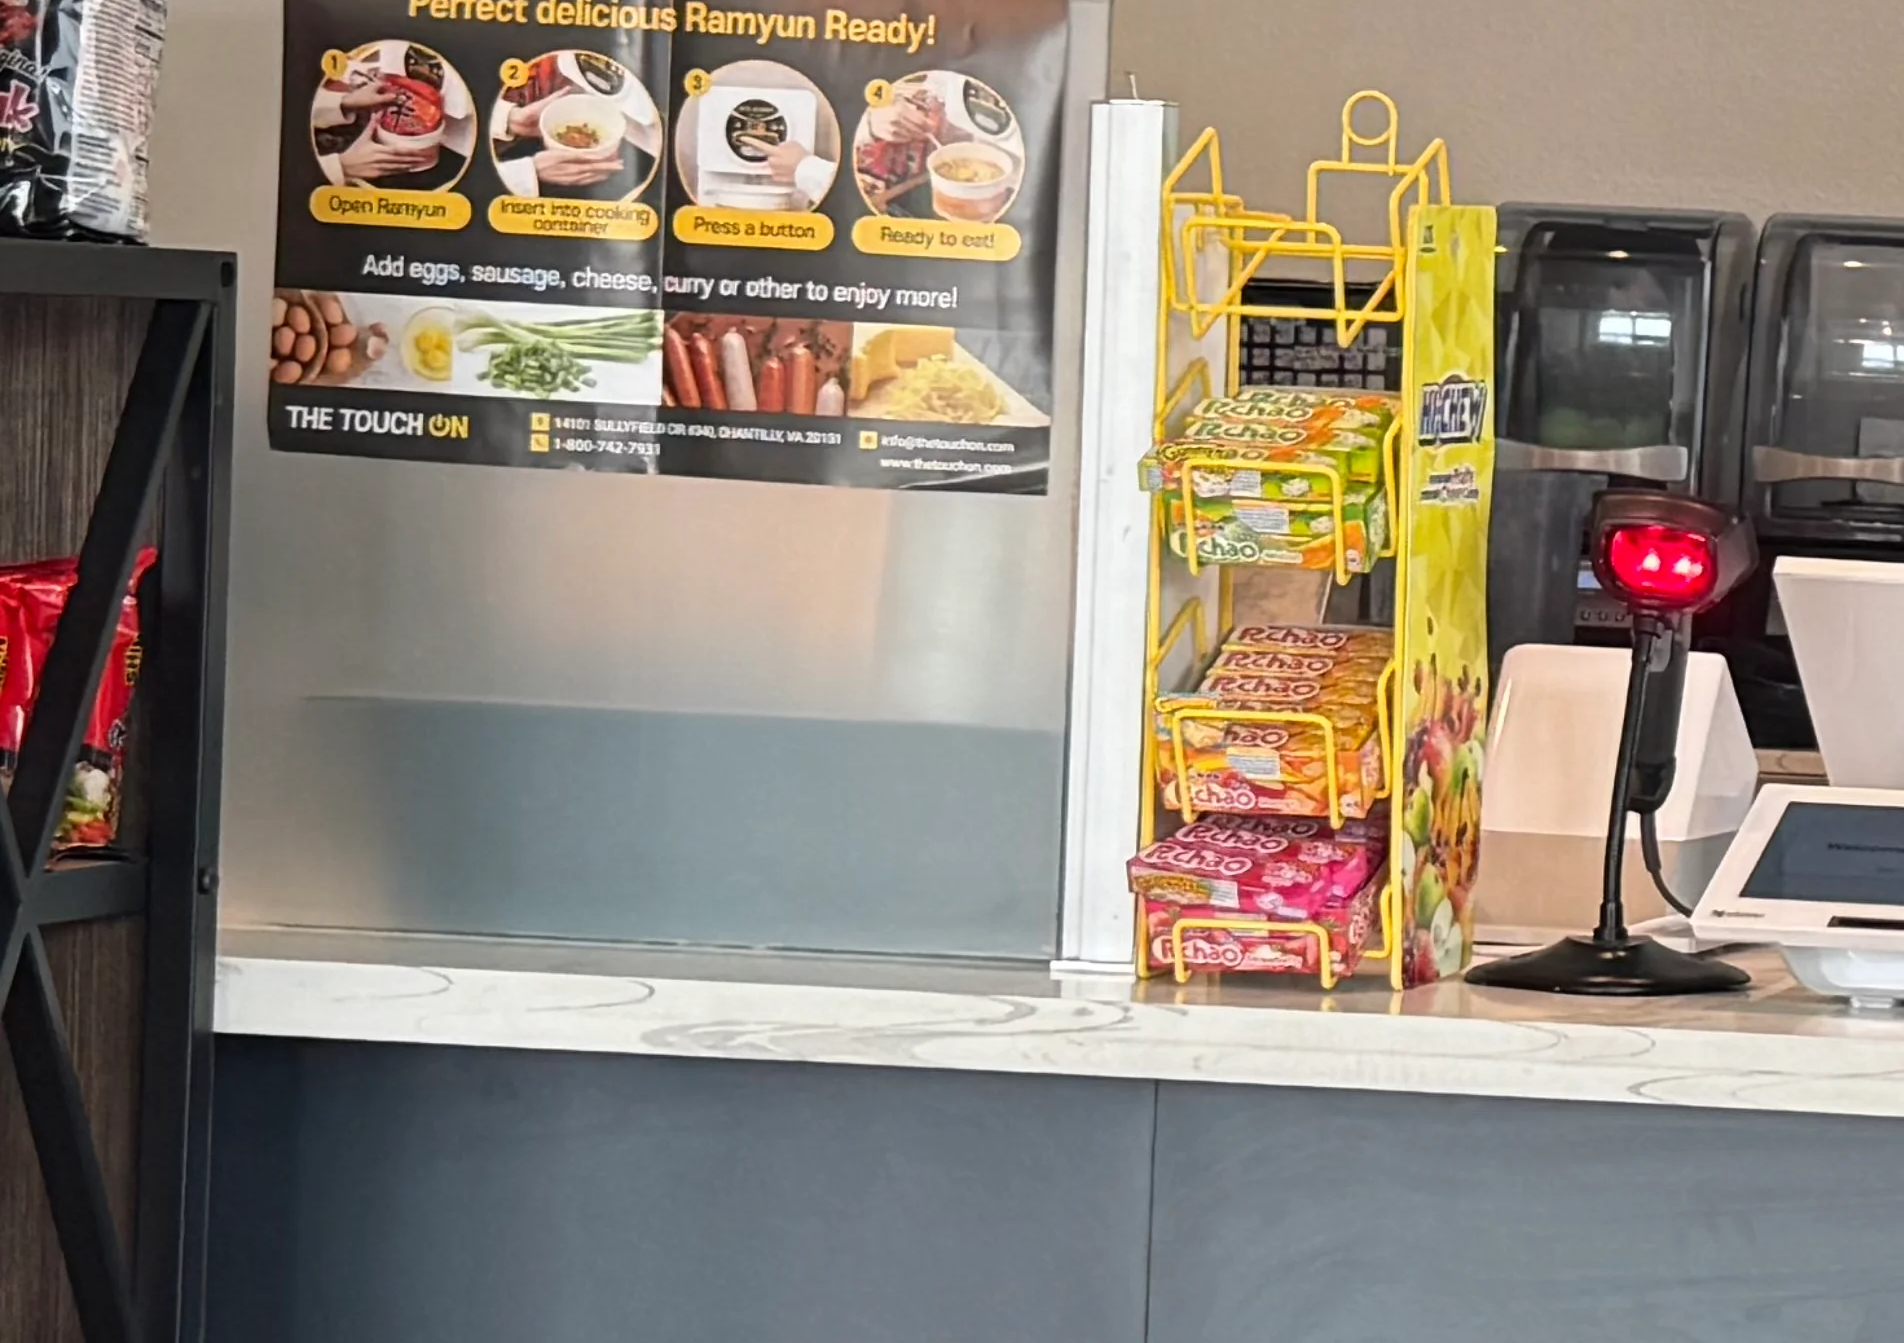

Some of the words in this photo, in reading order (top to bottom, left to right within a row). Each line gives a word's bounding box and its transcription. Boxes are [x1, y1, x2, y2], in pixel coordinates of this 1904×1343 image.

[686, 4, 816, 41] Ramyun
[826, 10, 935, 51] Ready!
[508, 64, 519, 81] 2
[691, 73, 703, 91] 3
[872, 84, 884, 100] 4
[329, 197, 372, 217] Open
[694, 216, 735, 235] Press
[745, 223, 755, 236] a
[760, 219, 815, 242] button
[881, 226, 934, 250] Ready
[940, 229, 956, 245] to
[363, 256, 404, 280] Add
[409, 260, 465, 286] eggs,
[472, 264, 565, 292] sausage,
[573, 269, 658, 294] cheese,
[664, 275, 713, 300] curry
[720, 279, 741, 298] or
[747, 276, 801, 300] other
[806, 280, 828, 301] to
[834, 283, 889, 309] enjoy
[895, 284, 958, 310] more!
[287, 406, 335, 431] THE
[339, 409, 424, 437] TOUCH
